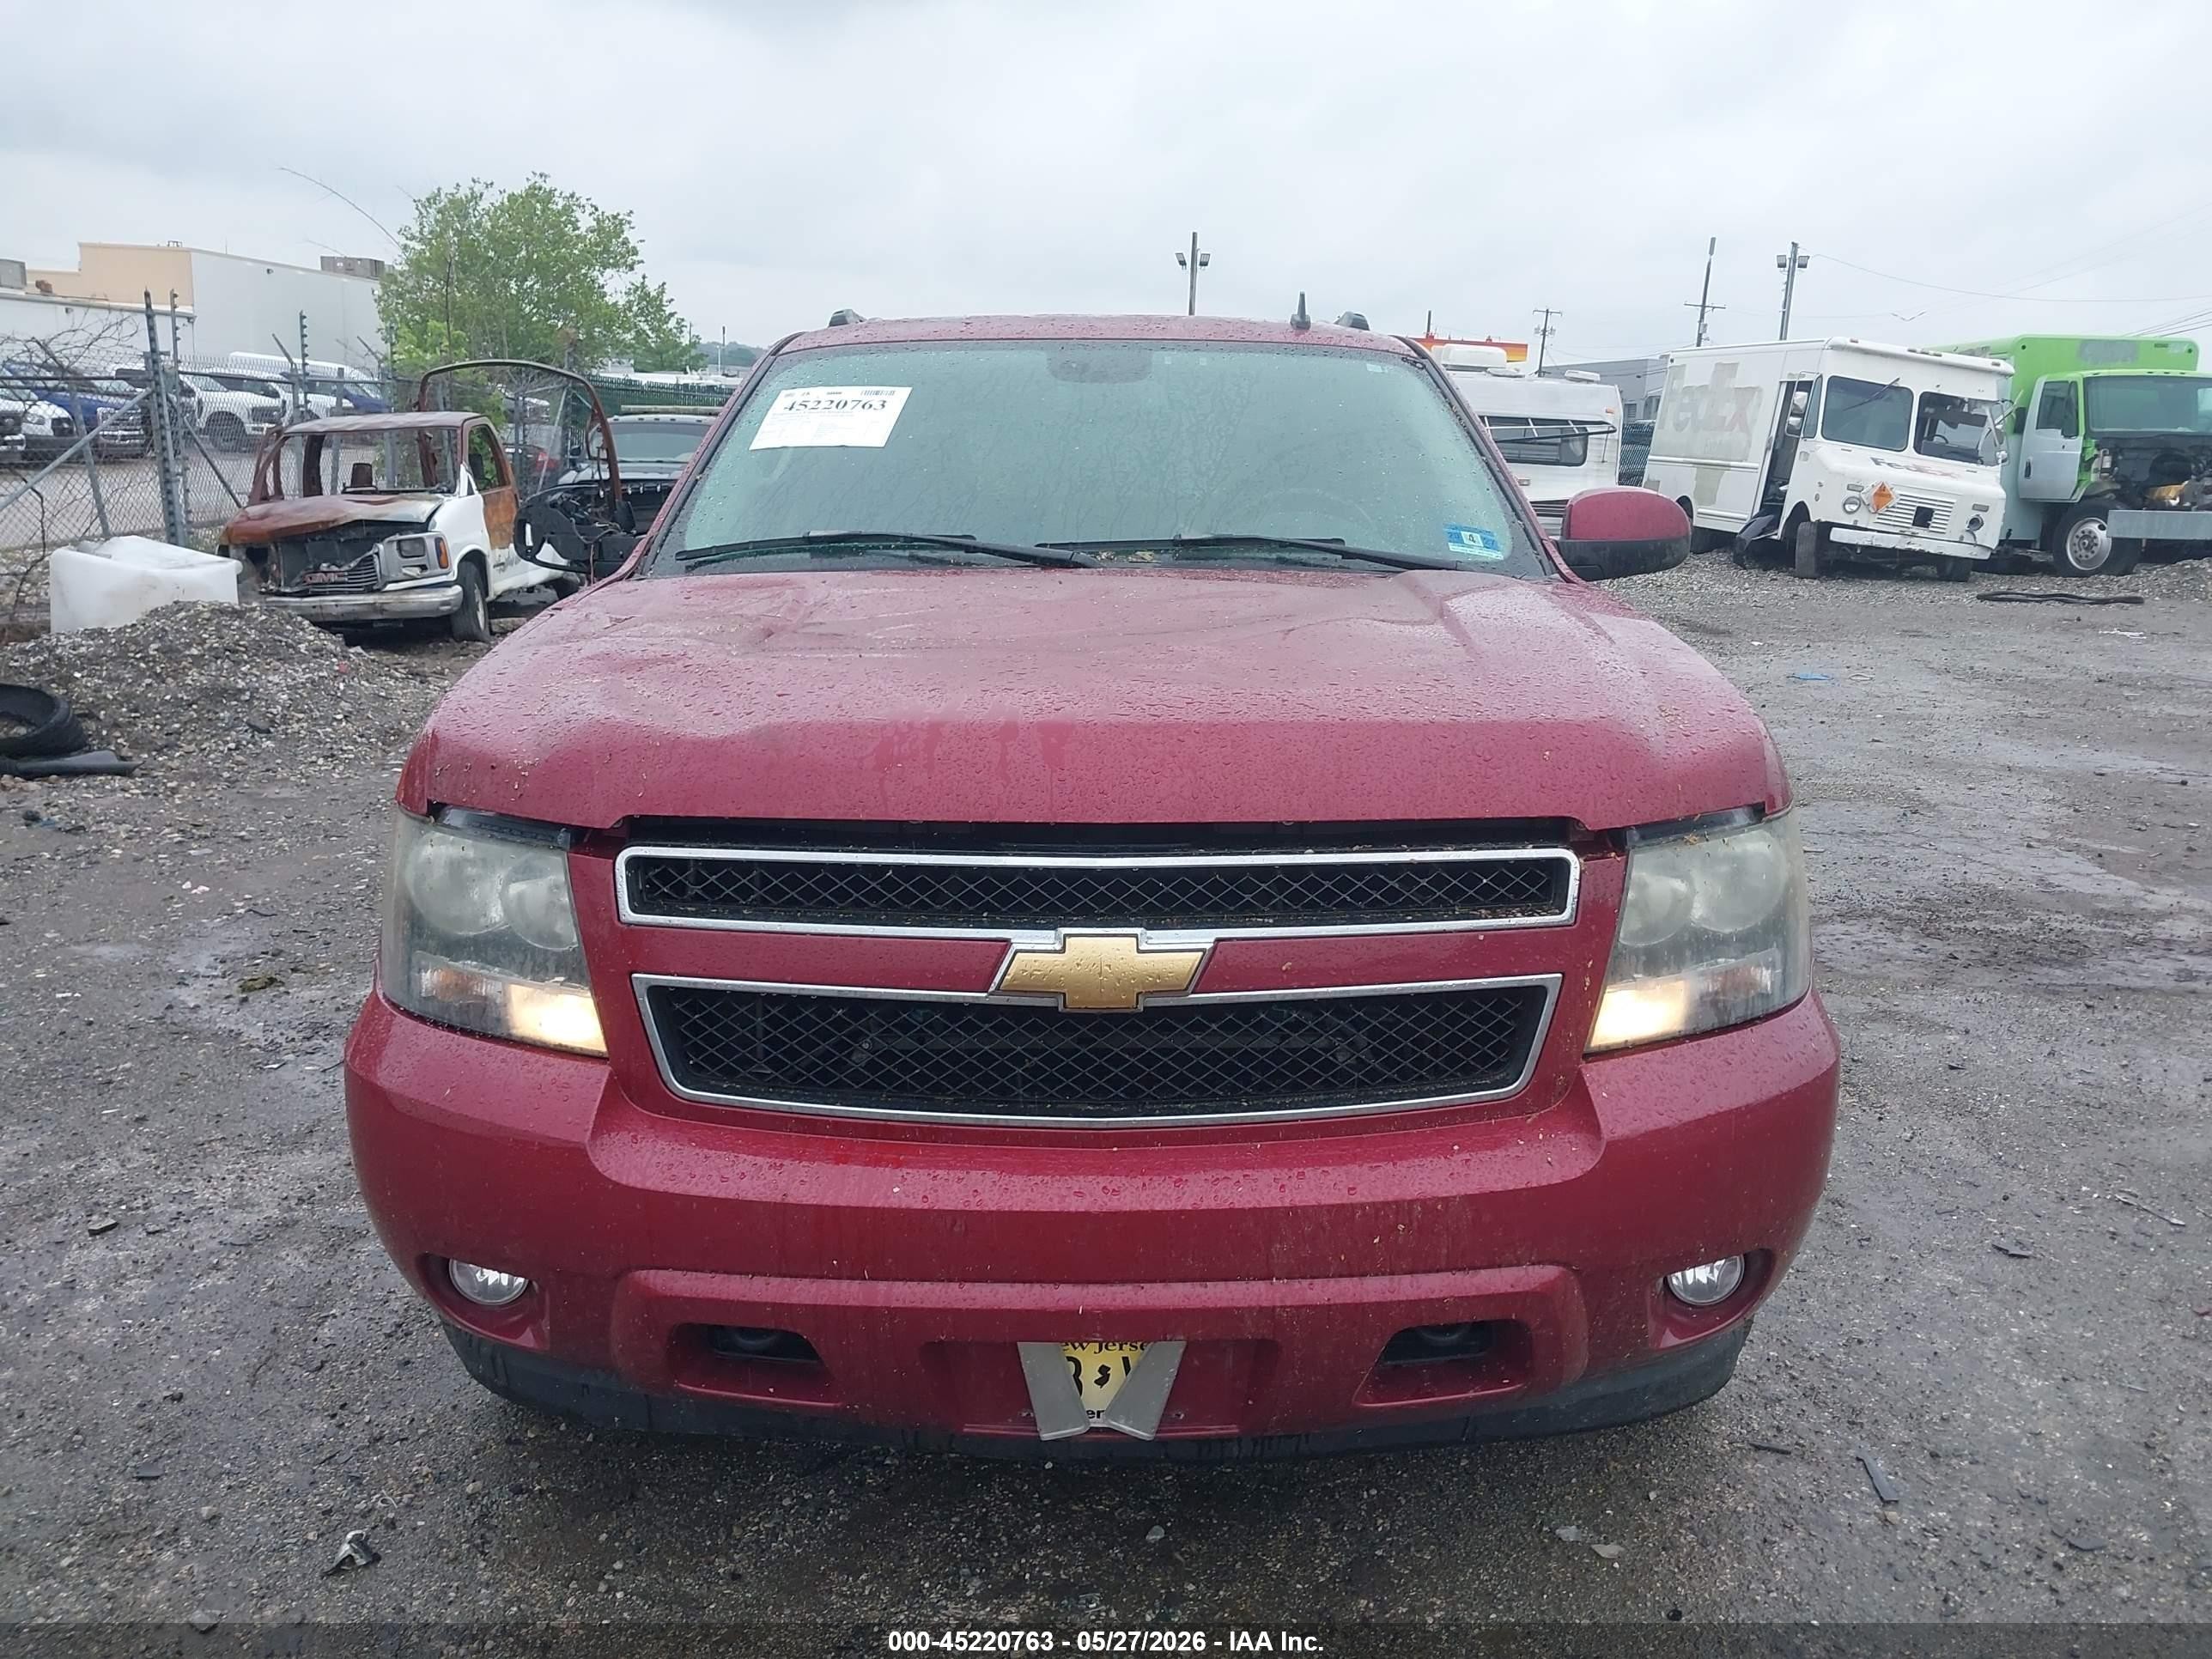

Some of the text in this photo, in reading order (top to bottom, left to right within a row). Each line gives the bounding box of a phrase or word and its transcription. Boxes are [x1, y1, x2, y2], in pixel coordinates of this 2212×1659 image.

[782, 399, 887, 412] 45220763
[302, 570, 349, 585] GMC
[1060, 1340, 1146, 1354] ew Jerse
